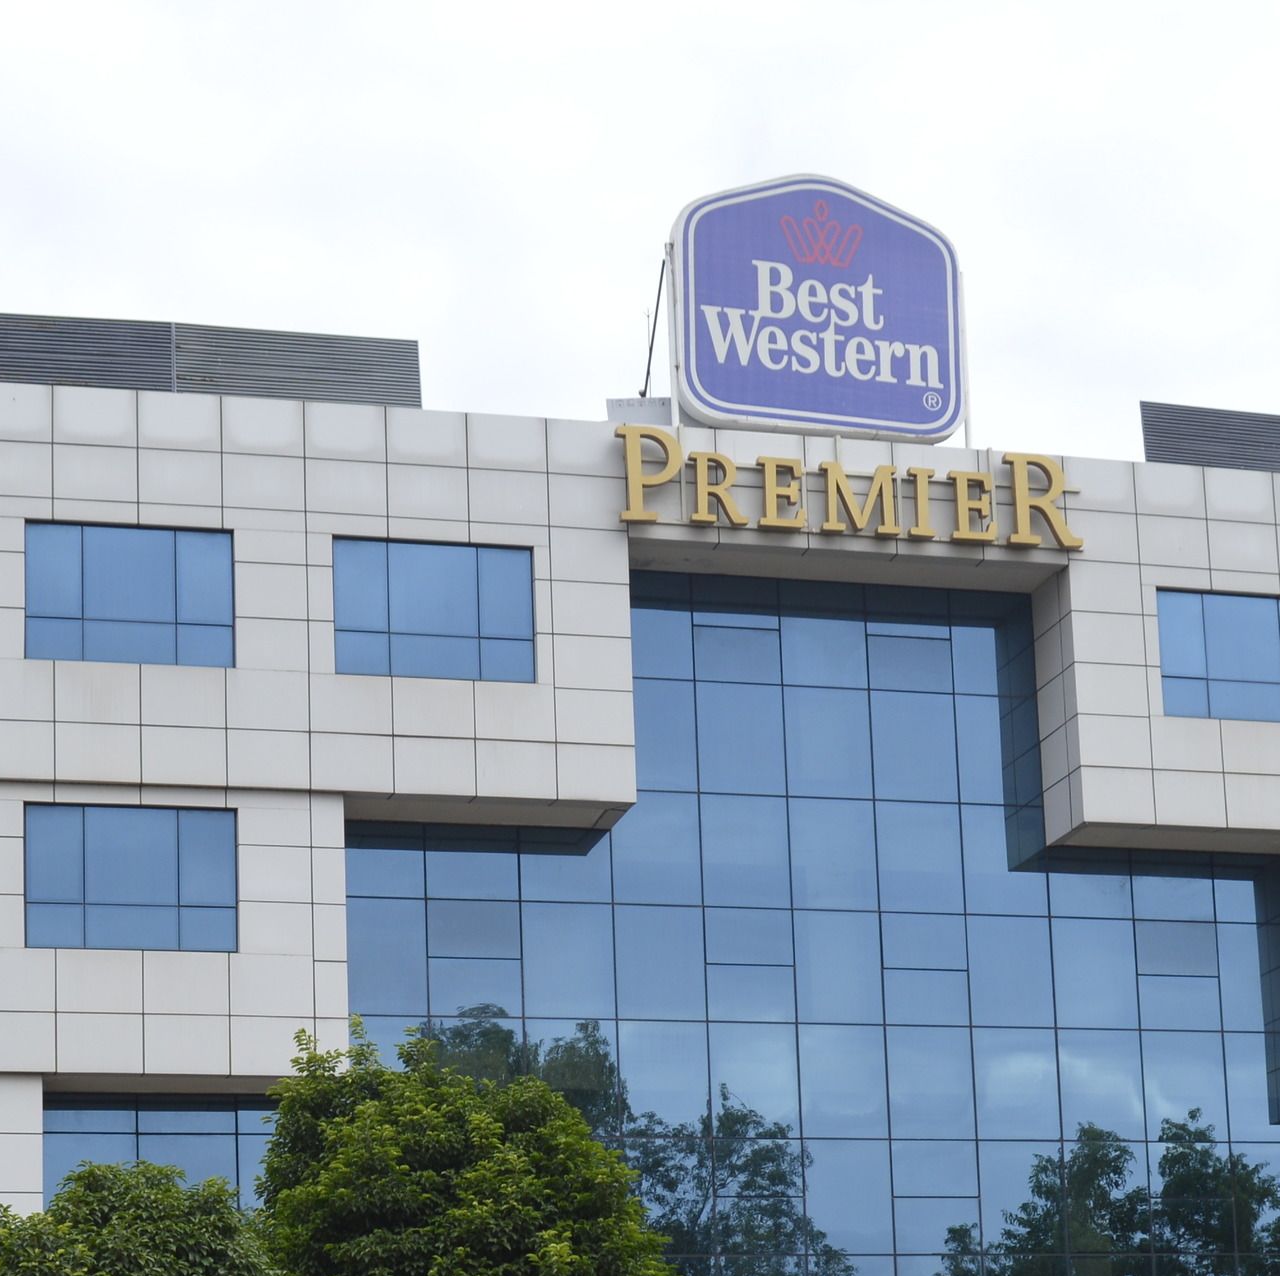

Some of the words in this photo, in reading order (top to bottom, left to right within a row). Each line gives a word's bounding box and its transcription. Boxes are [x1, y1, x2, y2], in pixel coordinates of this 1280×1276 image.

[751, 259, 884, 331] Best
[700, 304, 944, 389] Western
[614, 425, 1084, 551] PREMIER
